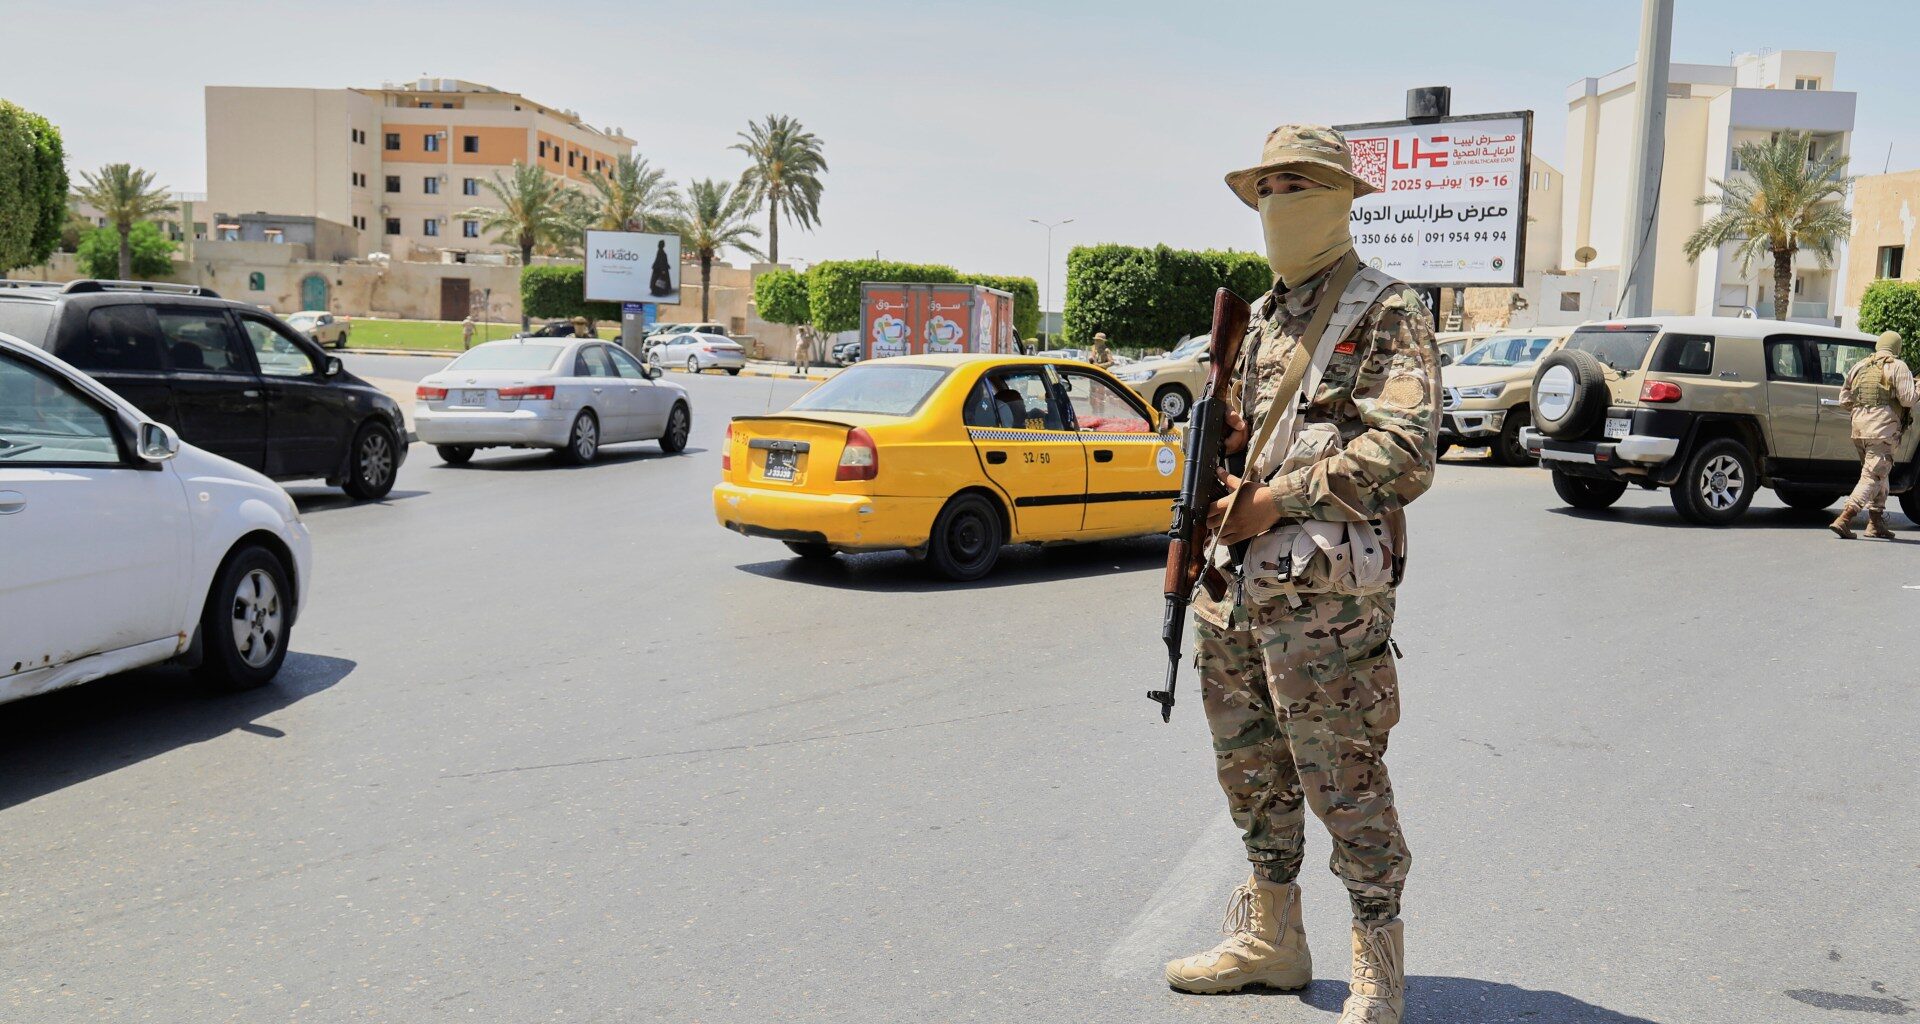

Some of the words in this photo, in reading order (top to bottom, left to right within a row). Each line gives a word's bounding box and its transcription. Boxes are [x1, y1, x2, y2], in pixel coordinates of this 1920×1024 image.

[1453, 135, 1475, 147] ليبيا
[1476, 134, 1516, 146] معرض
[1453, 148, 1481, 159] الصحية
[1482, 146, 1516, 157] للرعاية
[1391, 179, 1422, 191] 2025
[1425, 175, 1462, 190] يونيو
[1395, 204, 1454, 224] طرابلس
[1458, 204, 1508, 222] معرض
[1361, 234, 1381, 244] 350
[1384, 233, 1397, 243] 66
[1400, 233, 1414, 243] 66
[1425, 232, 1445, 243] 091
[1448, 231, 1470, 242] 954
[1474, 231, 1488, 242] 94
[1492, 231, 1507, 241] 94
[595, 249, 639, 261] Mikado
